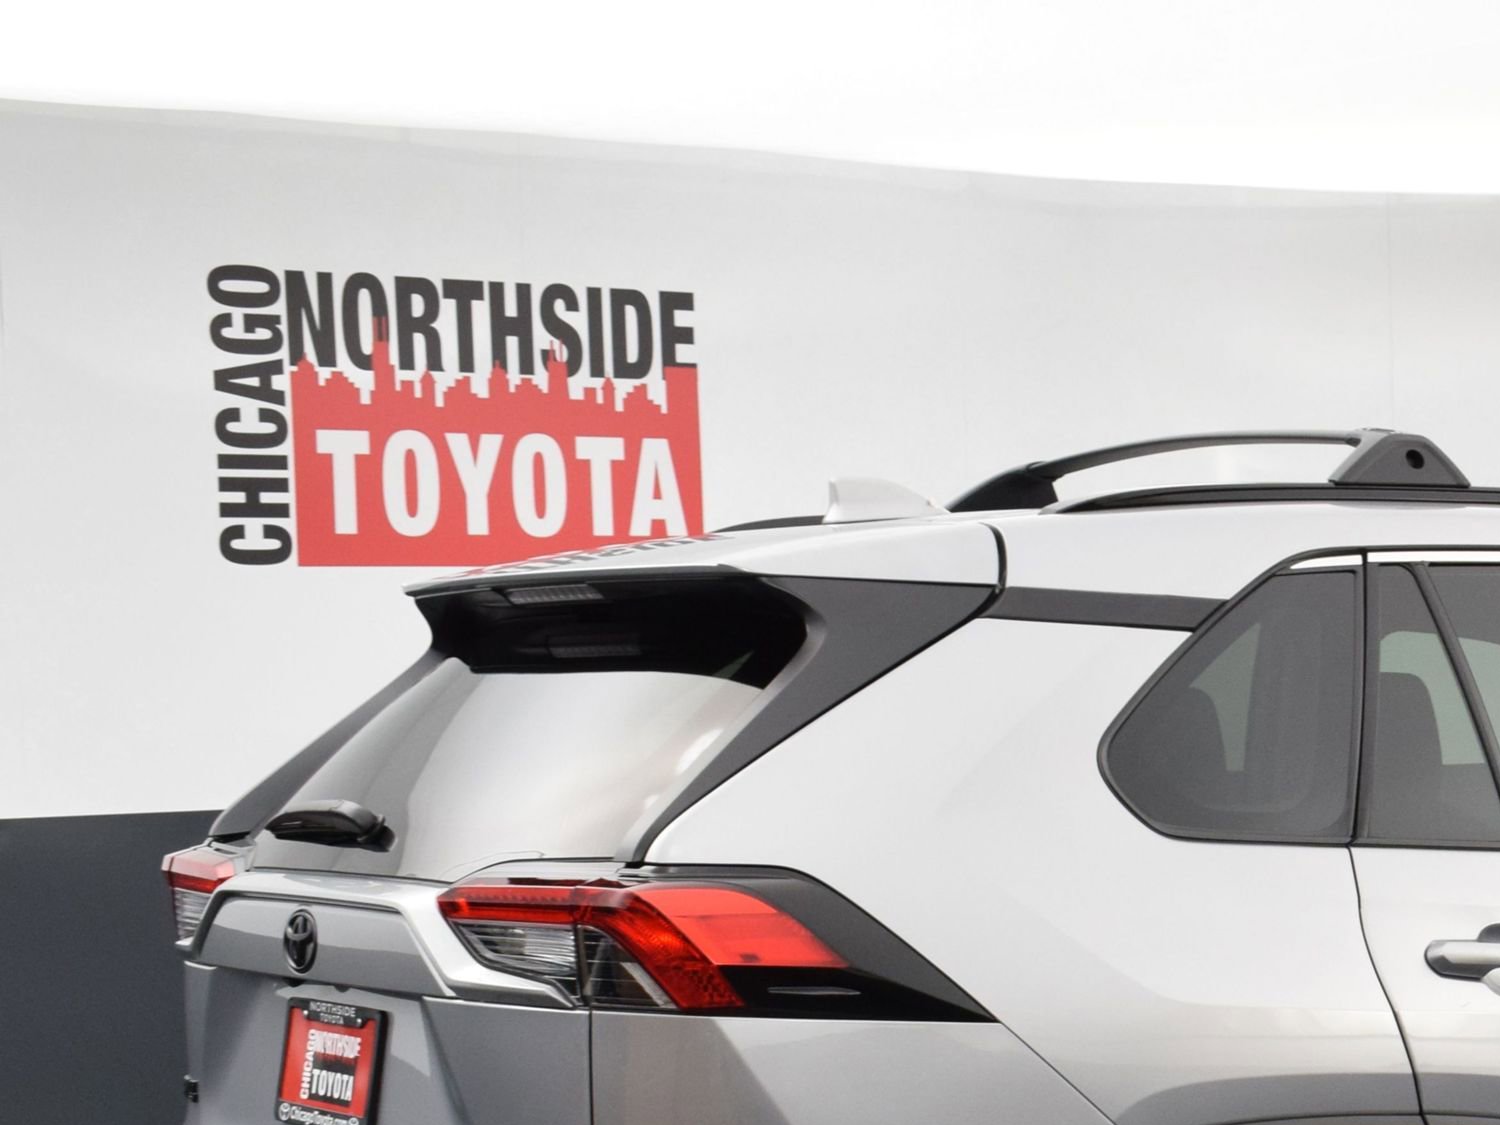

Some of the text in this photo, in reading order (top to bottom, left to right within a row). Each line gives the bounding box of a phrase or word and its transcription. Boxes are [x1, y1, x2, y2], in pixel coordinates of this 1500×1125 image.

[284, 269, 696, 380] NORTHSIDE
[207, 264, 293, 567] CHICAGO
[315, 429, 689, 539] TOYOTA
[309, 1001, 356, 1017] NORTHSIDE
[319, 1013, 345, 1025] TOYOTA
[300, 1029, 317, 1099] CHICAGO
[314, 1030, 361, 1059] NORTHSIDE
[311, 1069, 354, 1101] TOYOTA
